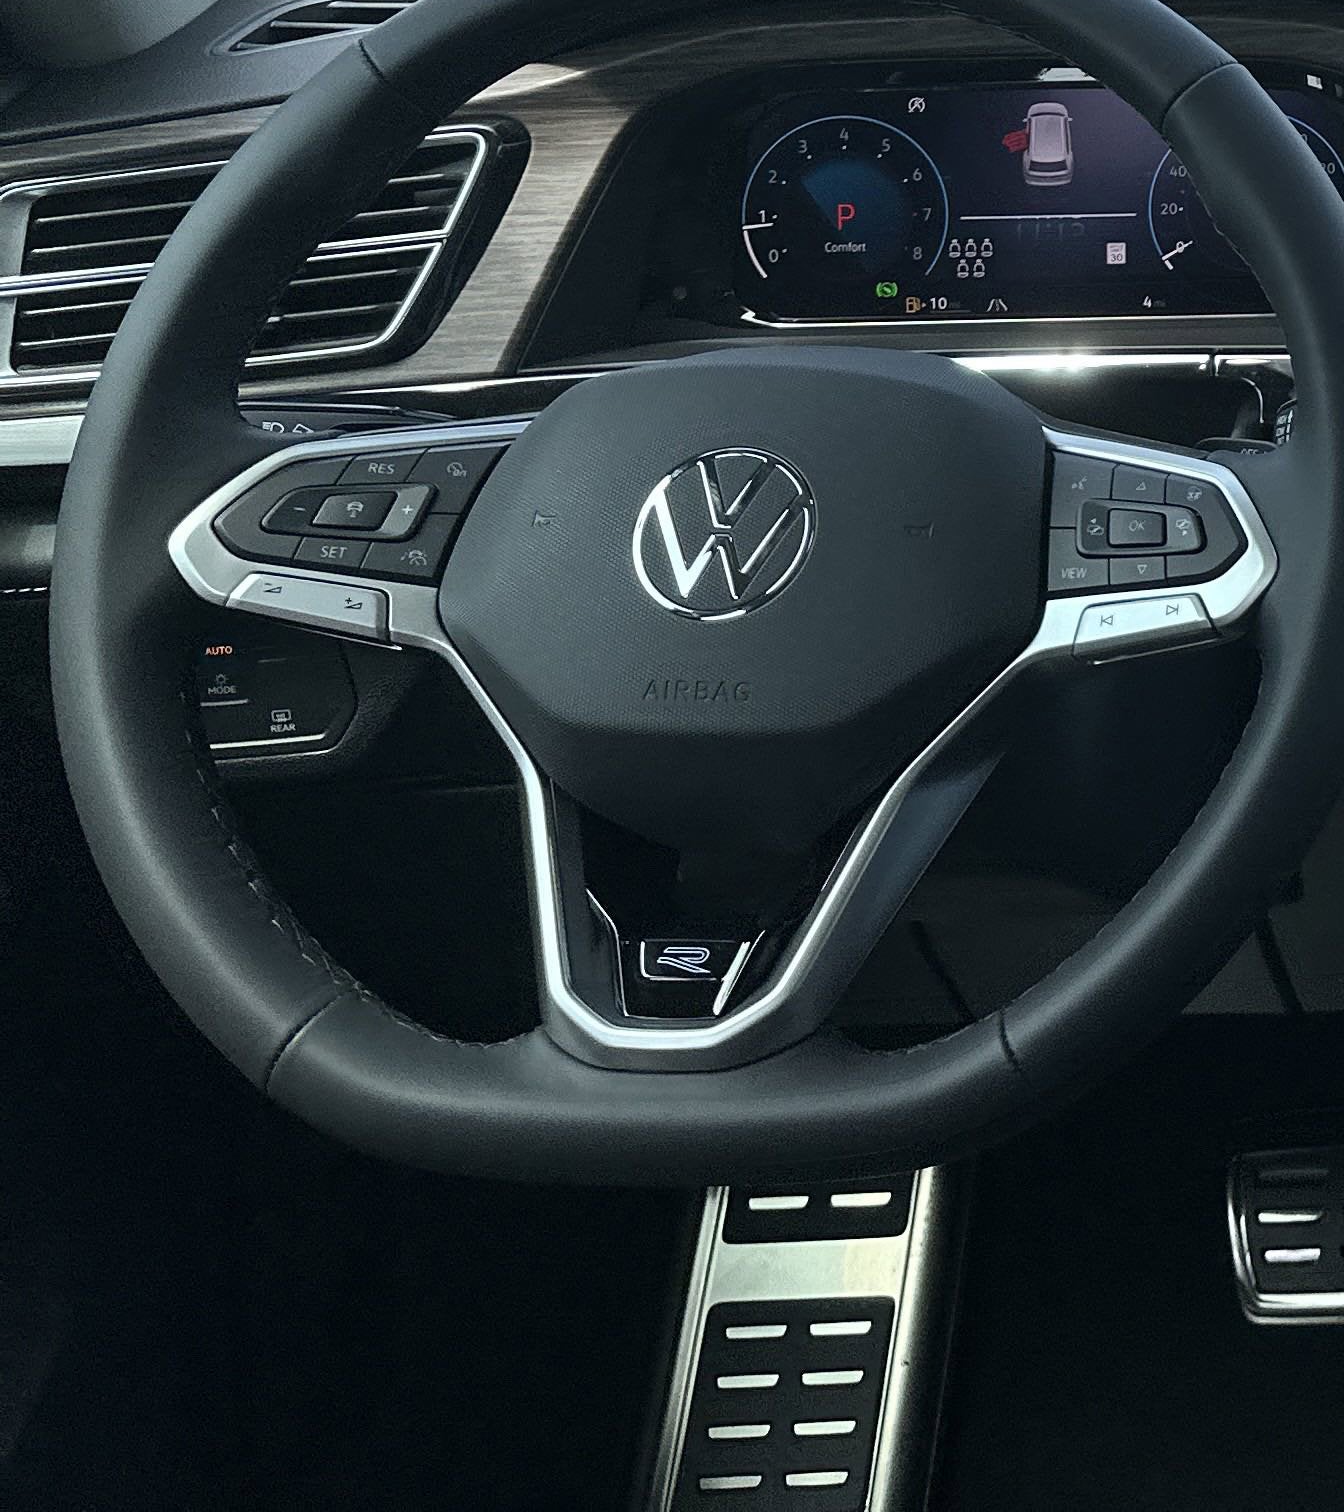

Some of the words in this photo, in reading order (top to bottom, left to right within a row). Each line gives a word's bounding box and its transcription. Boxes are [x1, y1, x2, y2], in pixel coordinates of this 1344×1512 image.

[839, 127, 849, 142] 4
[799, 140, 809, 154] 3
[882, 138, 891, 152] 5
[768, 170, 778, 184] 2
[912, 168, 923, 182] 6
[1169, 166, 1187, 178] 40
[758, 210, 767, 223] 1
[922, 208, 932, 222] 7
[1159, 204, 1177, 216] 20
[837, 203, 856, 231] P
[824, 241, 867, 253] Comfort
[768, 249, 779, 263] 0
[913, 247, 923, 261] 8
[1110, 253, 1123, 263] 30
[929, 297, 948, 310] 10
[1142, 297, 1153, 309] 4
[368, 462, 396, 475] RES
[1128, 519, 1146, 532] OK
[320, 545, 348, 559] SET
[1061, 567, 1088, 580] VIEW
[205, 645, 234, 656] AUTO
[207, 685, 238, 696] MODE
[642, 679, 752, 704] AIRBAG
[270, 723, 297, 733] REAR
